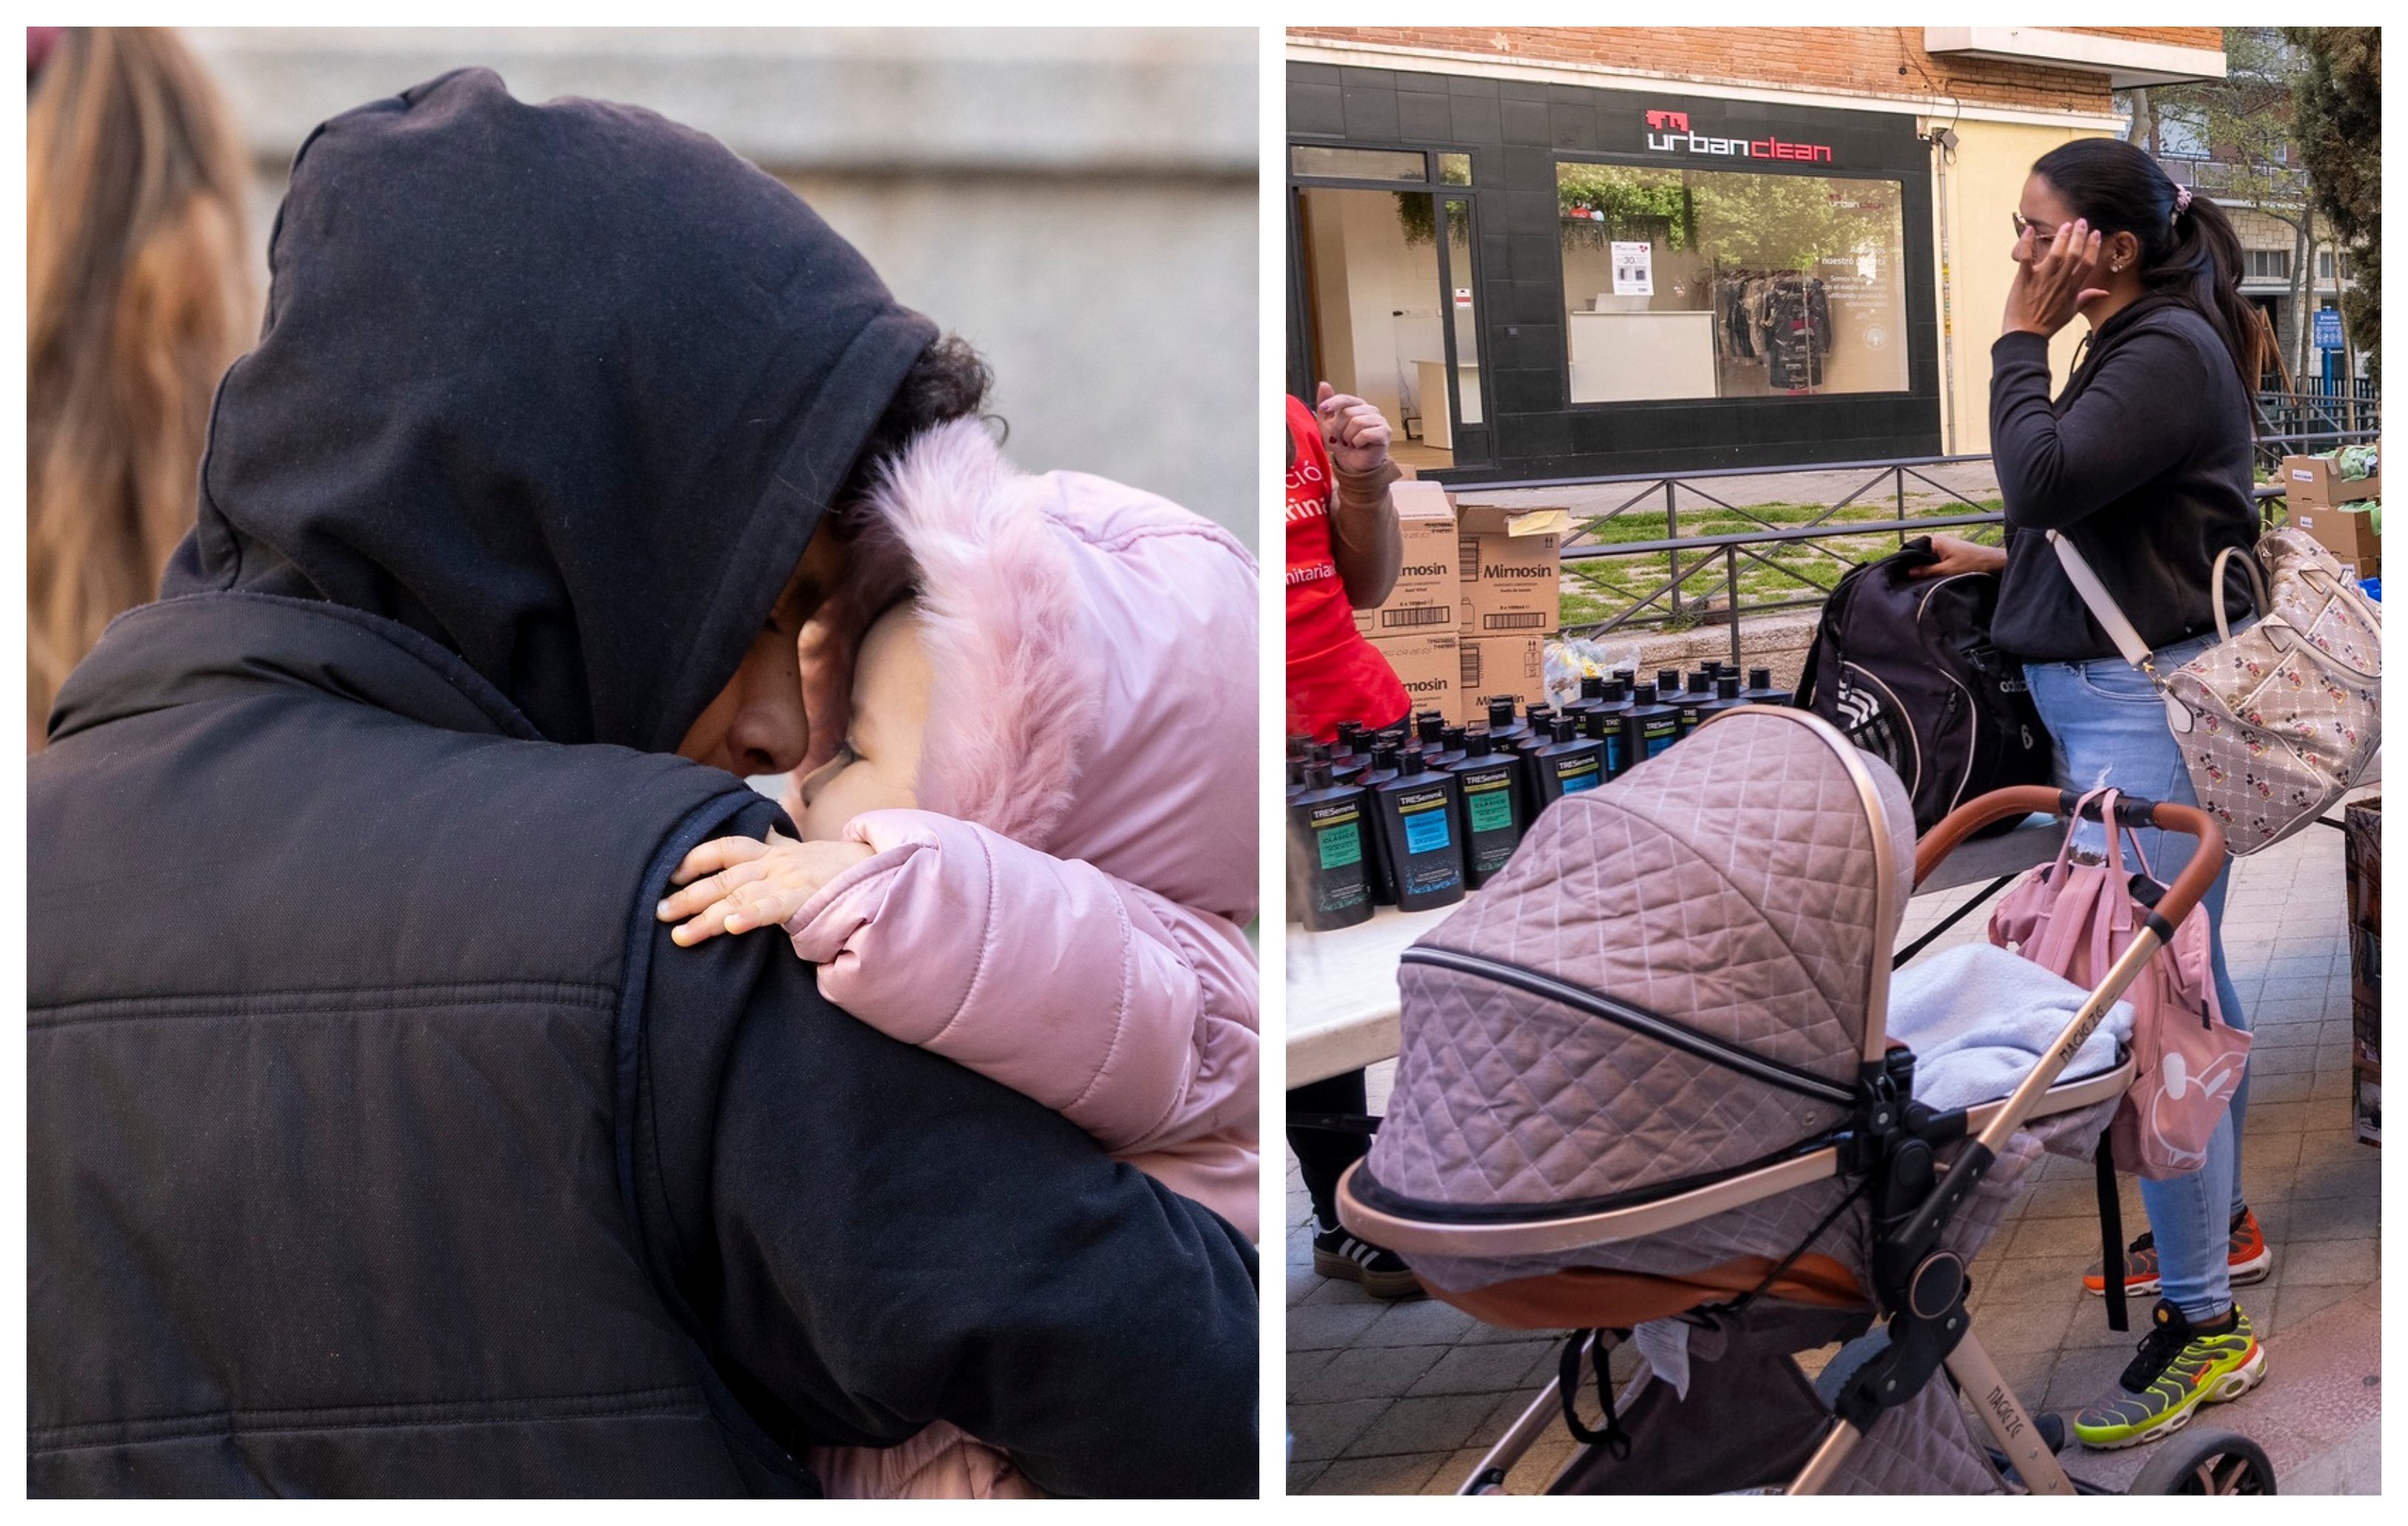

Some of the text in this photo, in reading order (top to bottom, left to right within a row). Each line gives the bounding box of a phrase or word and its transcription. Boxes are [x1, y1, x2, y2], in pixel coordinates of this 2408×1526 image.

[1647, 129, 1832, 162] urbanclean
[1821, 257, 1854, 266] nuestro
[1400, 563, 1447, 577] mosin
[1484, 563, 1552, 579] Mimosin
[1402, 677, 1448, 693] mosin
[1476, 693, 1525, 706] Miin
